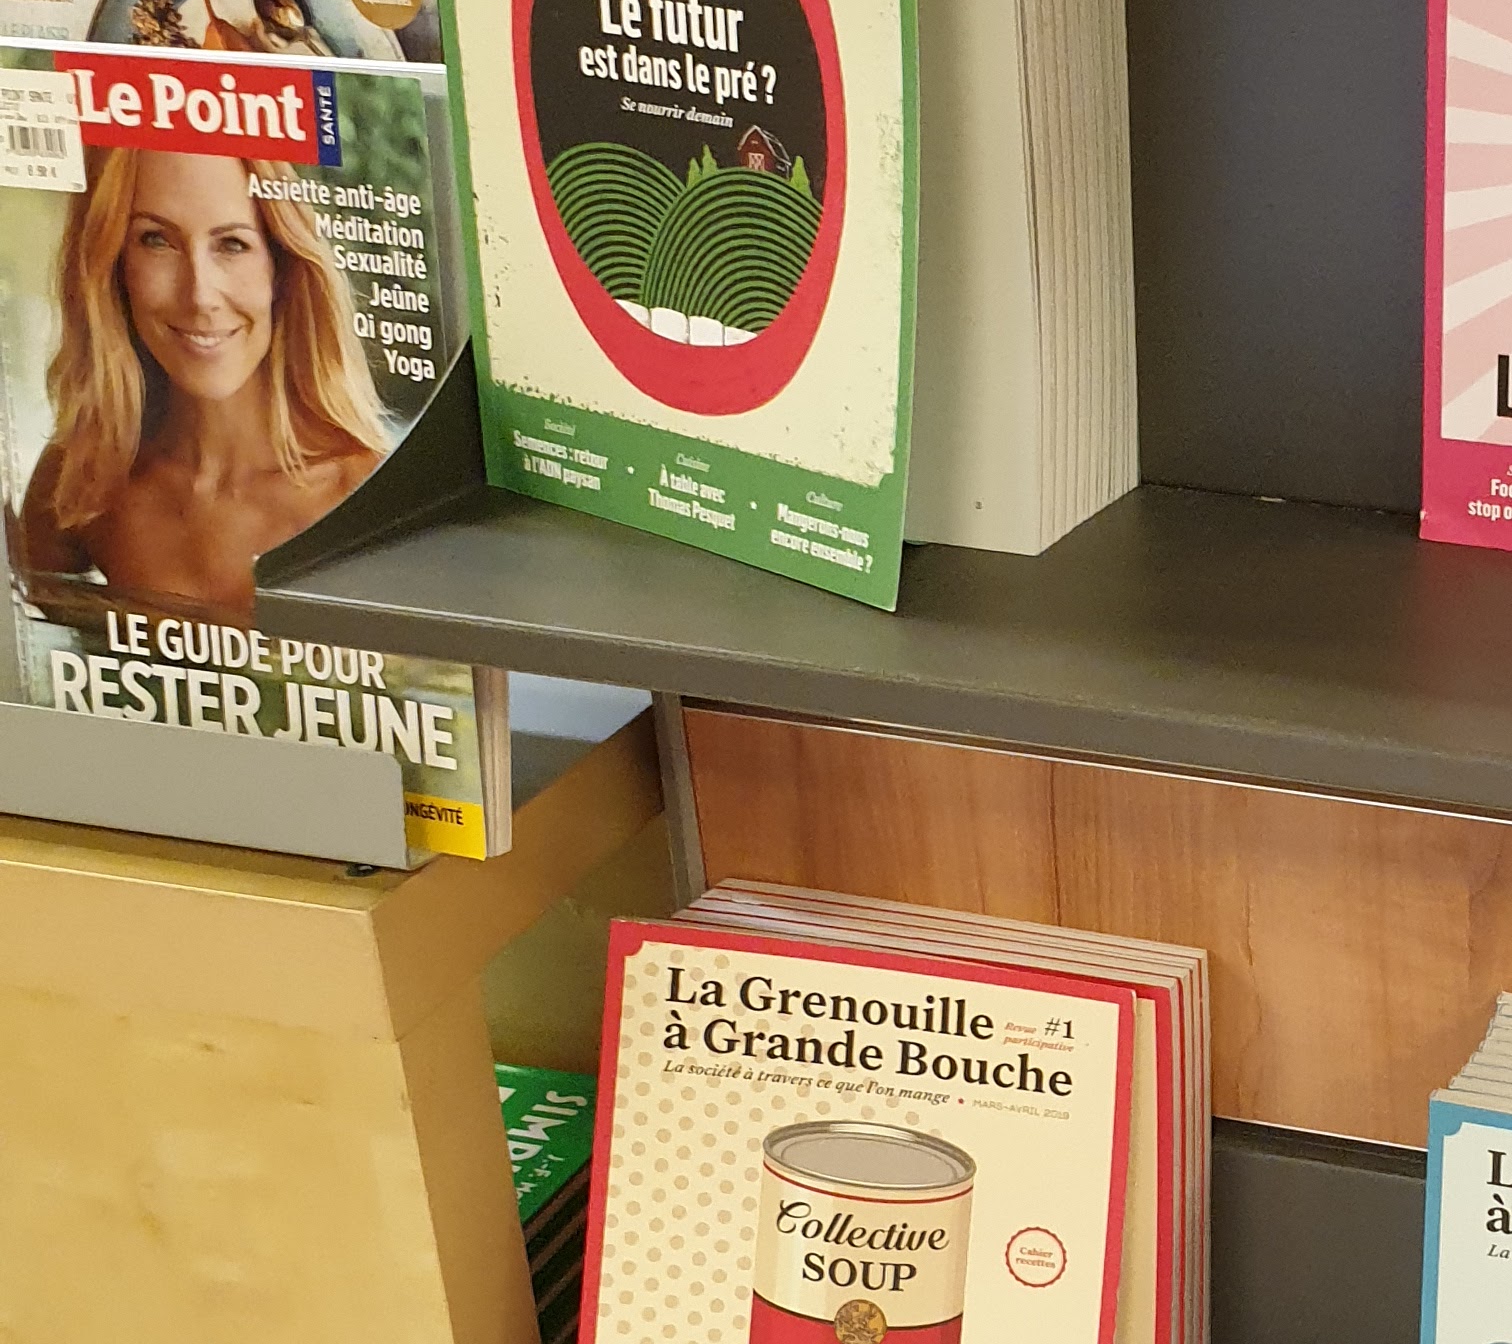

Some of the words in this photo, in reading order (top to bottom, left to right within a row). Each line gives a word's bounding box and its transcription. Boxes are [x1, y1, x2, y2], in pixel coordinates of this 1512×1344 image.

[579, 44, 619, 81] est
[622, 44, 682, 92] dans
[685, 52, 711, 96] le
[714, 60, 757, 106] pré
[760, 63, 778, 106] ?
[73, 68, 143, 128] Le
[149, 72, 307, 142] Point
[321, 85, 337, 147] SANTÉ
[248, 173, 331, 208] Assiette
[334, 182, 422, 217] anti-âge
[315, 215, 424, 248] Méditation
[334, 243, 427, 280] Sexualité
[369, 283, 430, 315] Jeûne
[352, 311, 376, 341] Qi
[380, 321, 432, 350] gong
[384, 348, 436, 383] Yoga
[1468, 498, 1502, 523] stop
[106, 610, 150, 656] LE
[157, 619, 273, 674] GUIDE
[280, 639, 387, 690] POUR
[50, 649, 265, 737] RESTER
[273, 681, 458, 772] JEUNE
[664, 966, 725, 1008] La
[738, 974, 995, 1041] Grenouille
[1043, 1016, 1076, 1040] #1
[663, 1009, 690, 1051] à
[703, 1016, 883, 1072] Grande
[896, 1039, 1074, 1096] Bouche
[774, 1198, 950, 1252] Collective
[802, 1251, 918, 1293] SOUP
